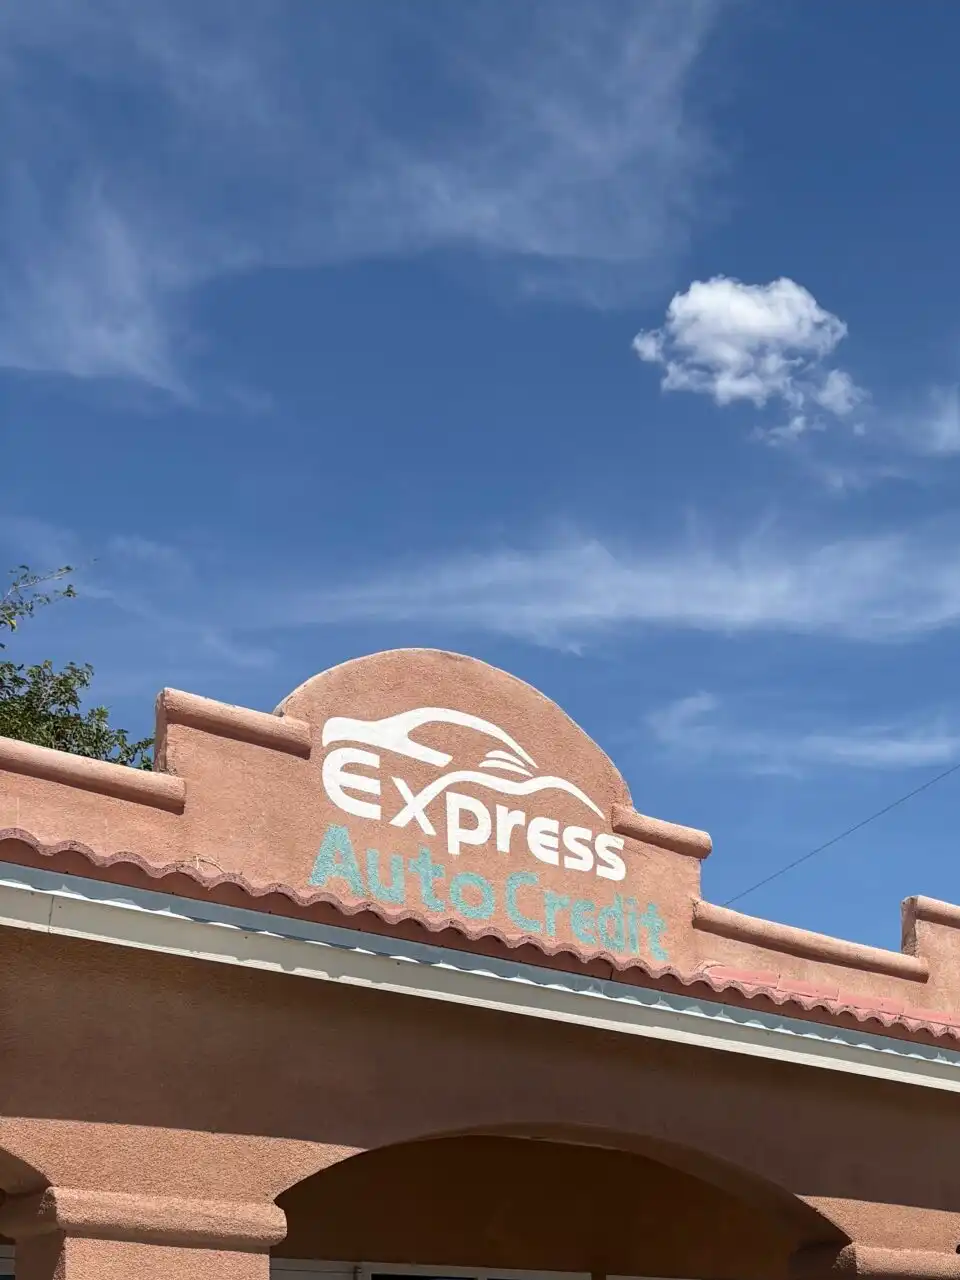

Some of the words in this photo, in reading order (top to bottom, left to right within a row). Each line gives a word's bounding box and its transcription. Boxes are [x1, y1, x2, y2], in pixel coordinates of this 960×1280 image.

[322, 747, 627, 881] Express
[309, 824, 496, 921] Auto
[507, 871, 670, 961] Credit
